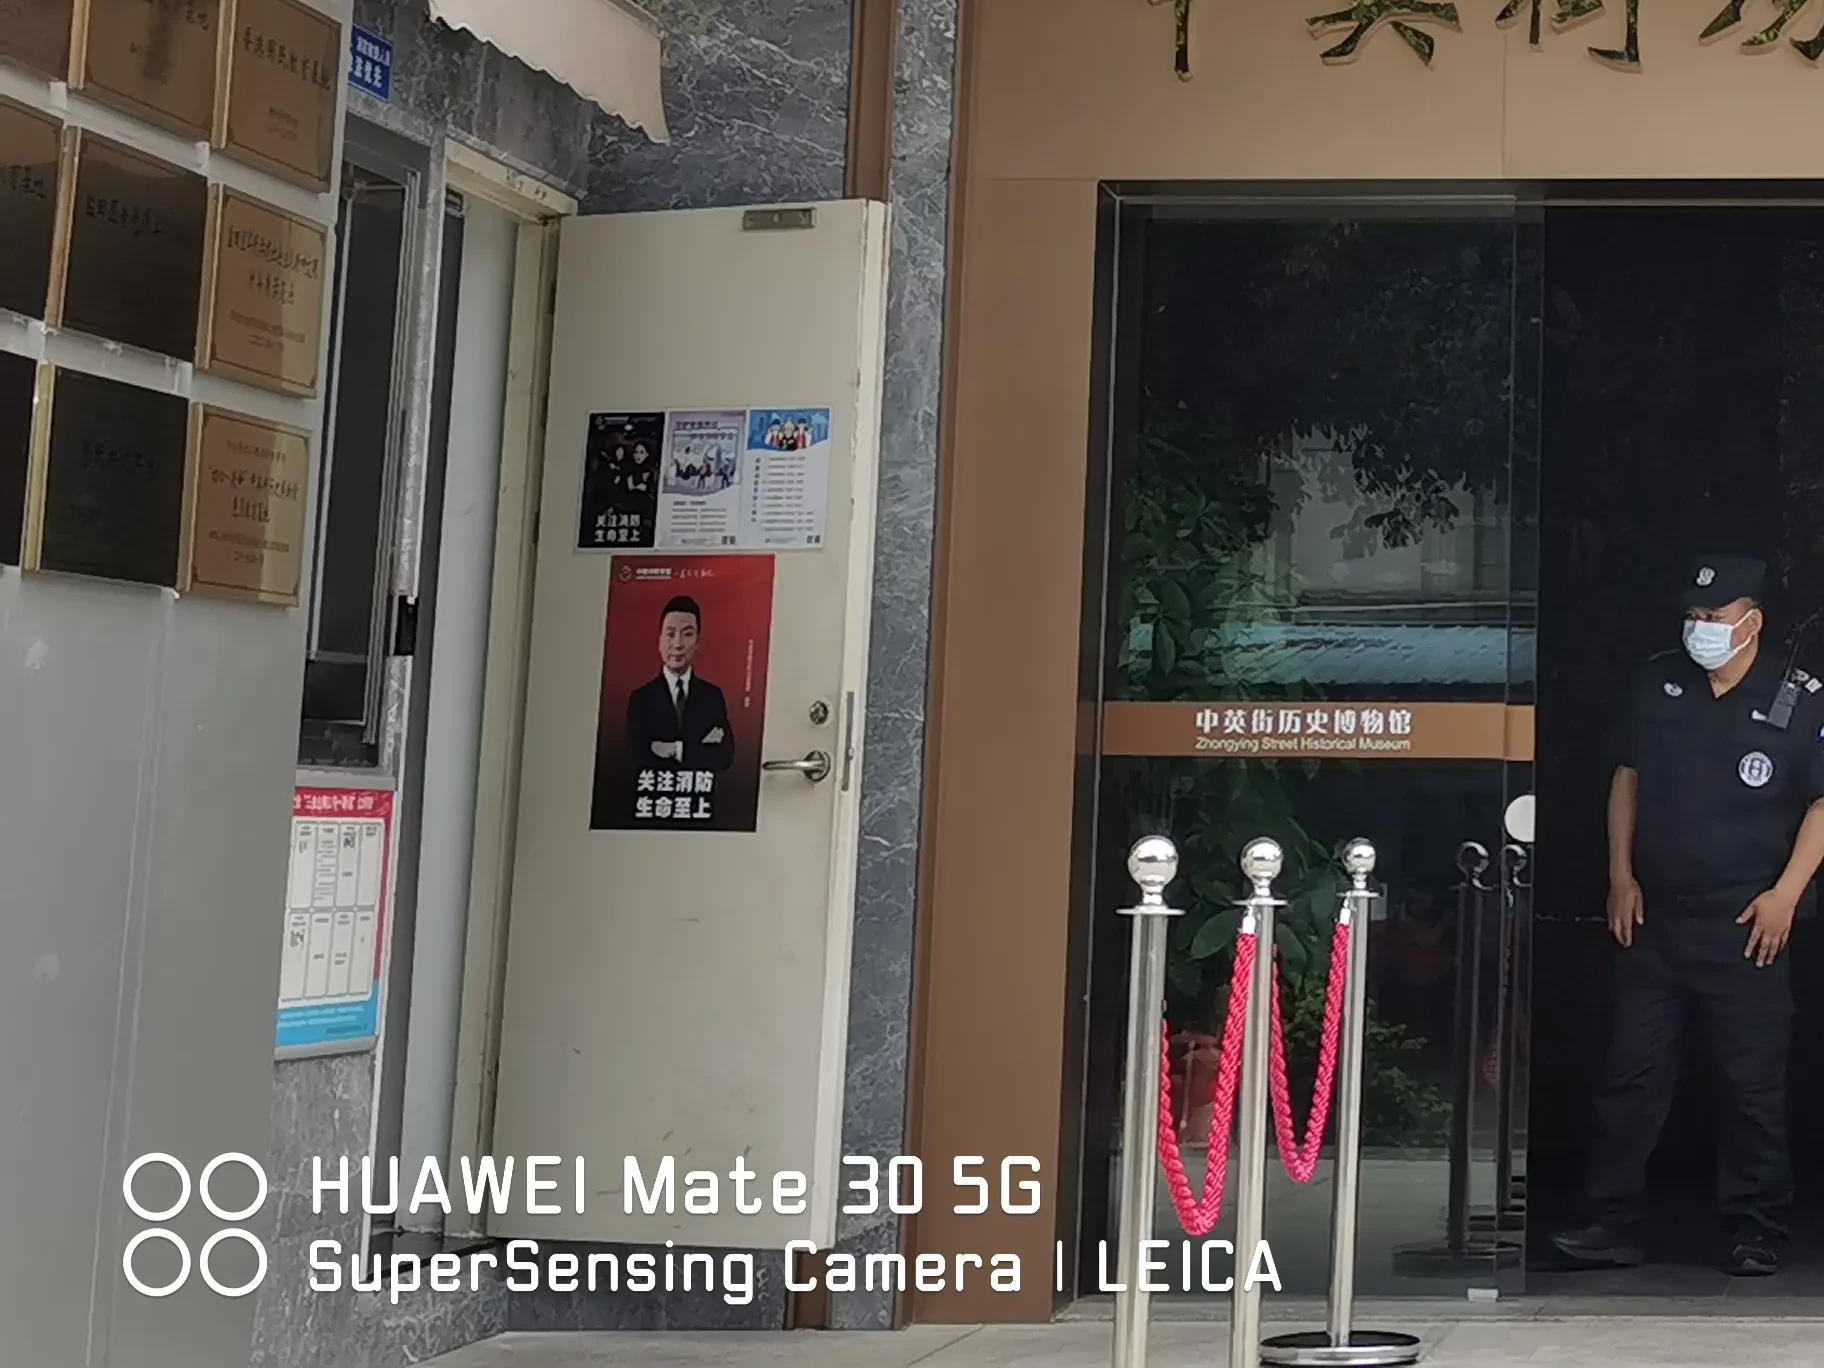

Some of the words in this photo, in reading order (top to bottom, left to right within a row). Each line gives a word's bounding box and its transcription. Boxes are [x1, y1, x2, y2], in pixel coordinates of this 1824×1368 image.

[1194, 707, 1412, 735] 中英街历史博物馆
[1194, 736, 1259, 753] Zhongying
[1261, 736, 1298, 750] Street
[1300, 736, 1357, 751] Historical
[1358, 737, 1411, 751] Museum
[637, 769, 714, 793] 关注消防
[635, 796, 712, 818] 生命至上
